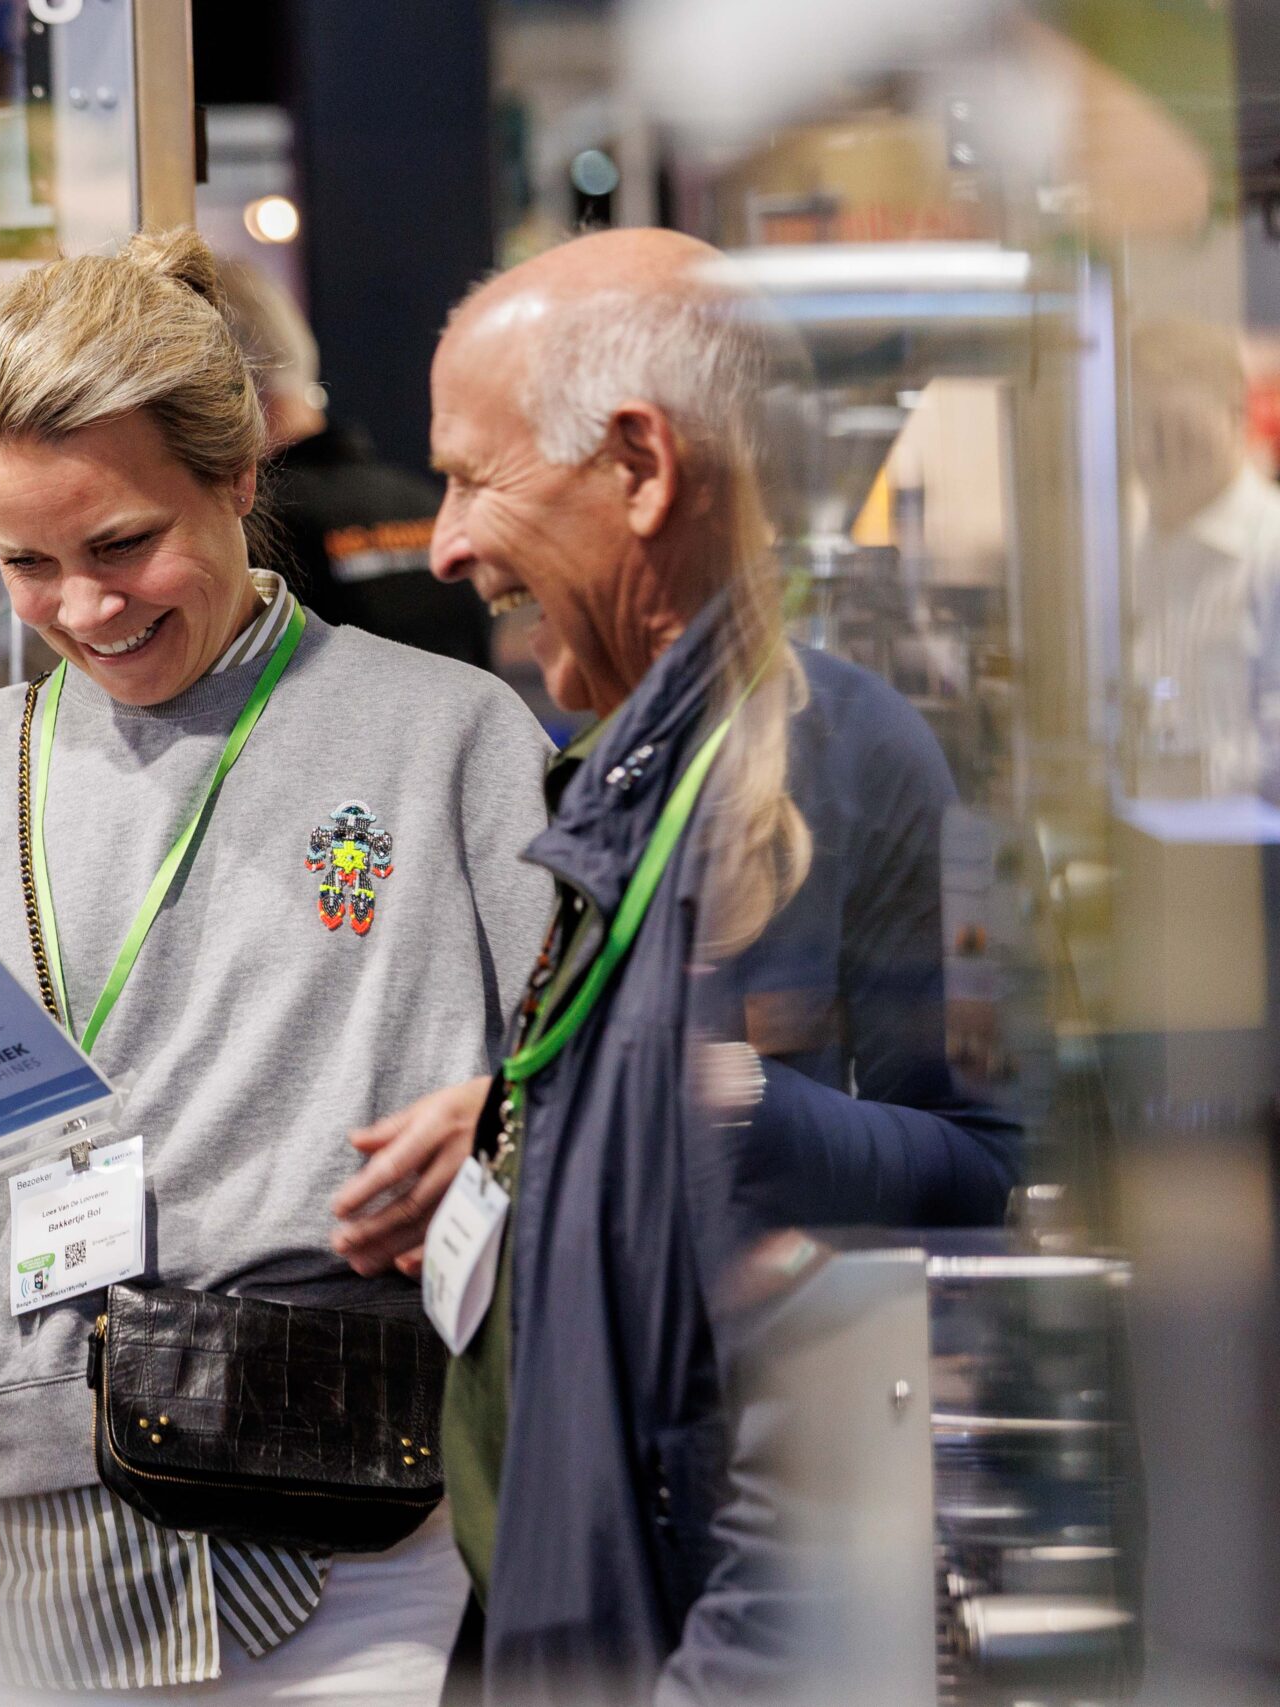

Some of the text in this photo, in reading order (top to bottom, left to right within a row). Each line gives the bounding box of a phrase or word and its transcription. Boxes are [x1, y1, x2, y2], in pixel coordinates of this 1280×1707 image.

[16, 1172, 53, 1190] Bezoeker
[42, 1207, 57, 1218] Loes
[58, 1201, 70, 1212] Van
[70, 1199, 79, 1208] De
[48, 1213, 85, 1233] Bakkertje
